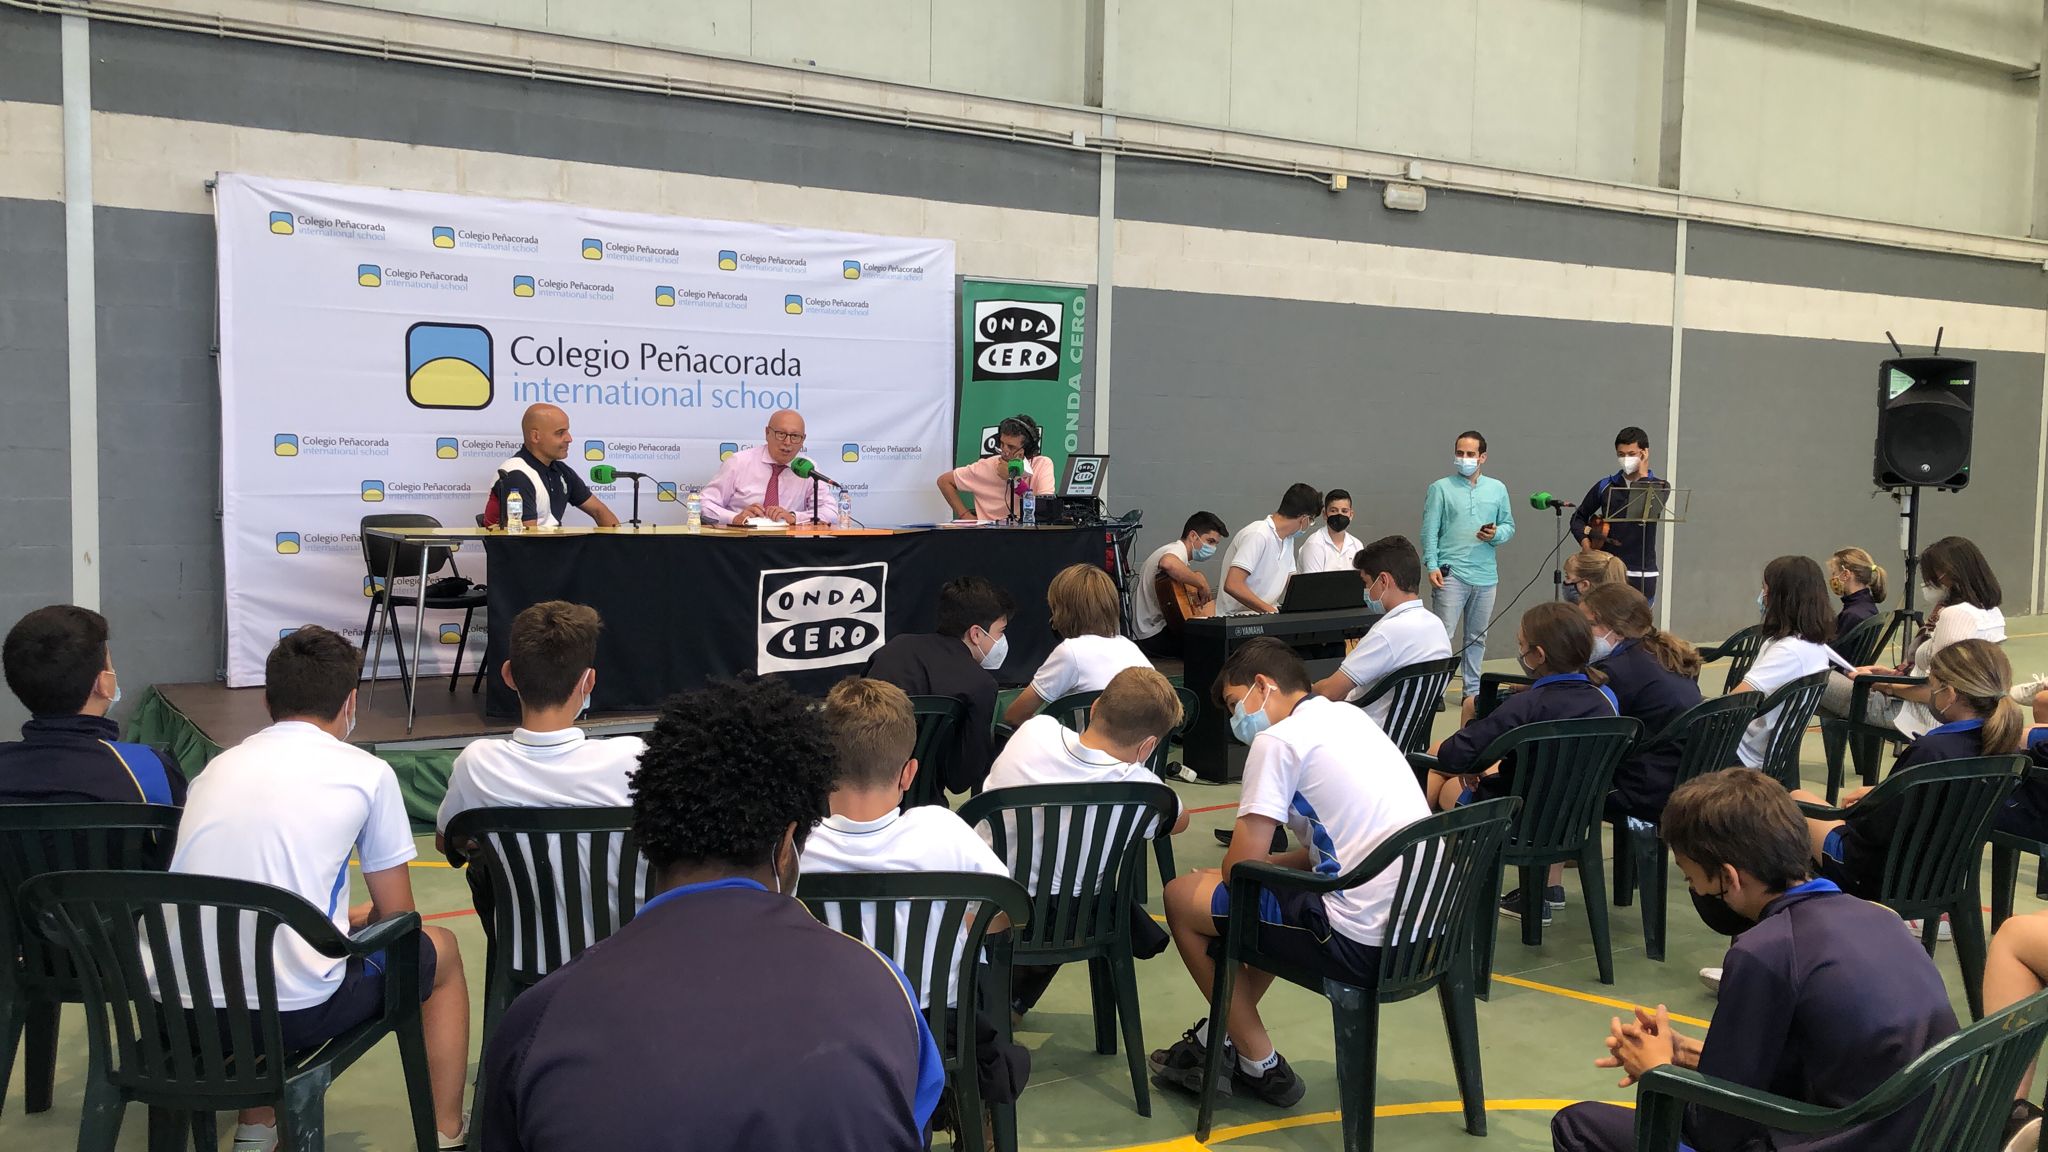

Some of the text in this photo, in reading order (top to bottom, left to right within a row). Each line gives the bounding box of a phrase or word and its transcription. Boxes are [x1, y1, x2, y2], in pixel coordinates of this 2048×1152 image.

[297, 216, 386, 232] Colegio Peñacorada
[298, 227, 386, 240] international school
[458, 230, 538, 244] Colegio Peñacorada
[459, 241, 538, 252] international school
[606, 242, 679, 256] Colegio Peñacorada
[606, 253, 678, 264] international school
[740, 254, 806, 266] Colegio Peñacorada
[385, 268, 468, 282] Colegio Peñacorada
[863, 263, 924, 274] Colegio Peñacorada
[386, 278, 468, 292] international school
[538, 279, 614, 292] Colegio Peñacorada
[538, 290, 614, 300] international school
[678, 289, 748, 302] Colegio Peñacorada
[806, 298, 869, 308] Colegio Peñacorada
[986, 317, 1048, 334] ONDA
[510, 336, 802, 377] Colegio Peñacorada
[988, 348, 1046, 366] CERO
[1064, 296, 1086, 452] ONDA CERO
[513, 372, 800, 410] international school
[302, 436, 389, 447] Colegio Peñacorada
[462, 440, 494, 450] Colegio
[608, 442, 680, 452] Colegio Peñacorada
[862, 445, 886, 454] Colegio
[388, 482, 471, 492] Colegio Peñacorada
[304, 534, 338, 544] Colegio
[778, 588, 866, 610] ONDA
[1242, 625, 1264, 636] YAMAHA
[782, 626, 866, 652] CERO
